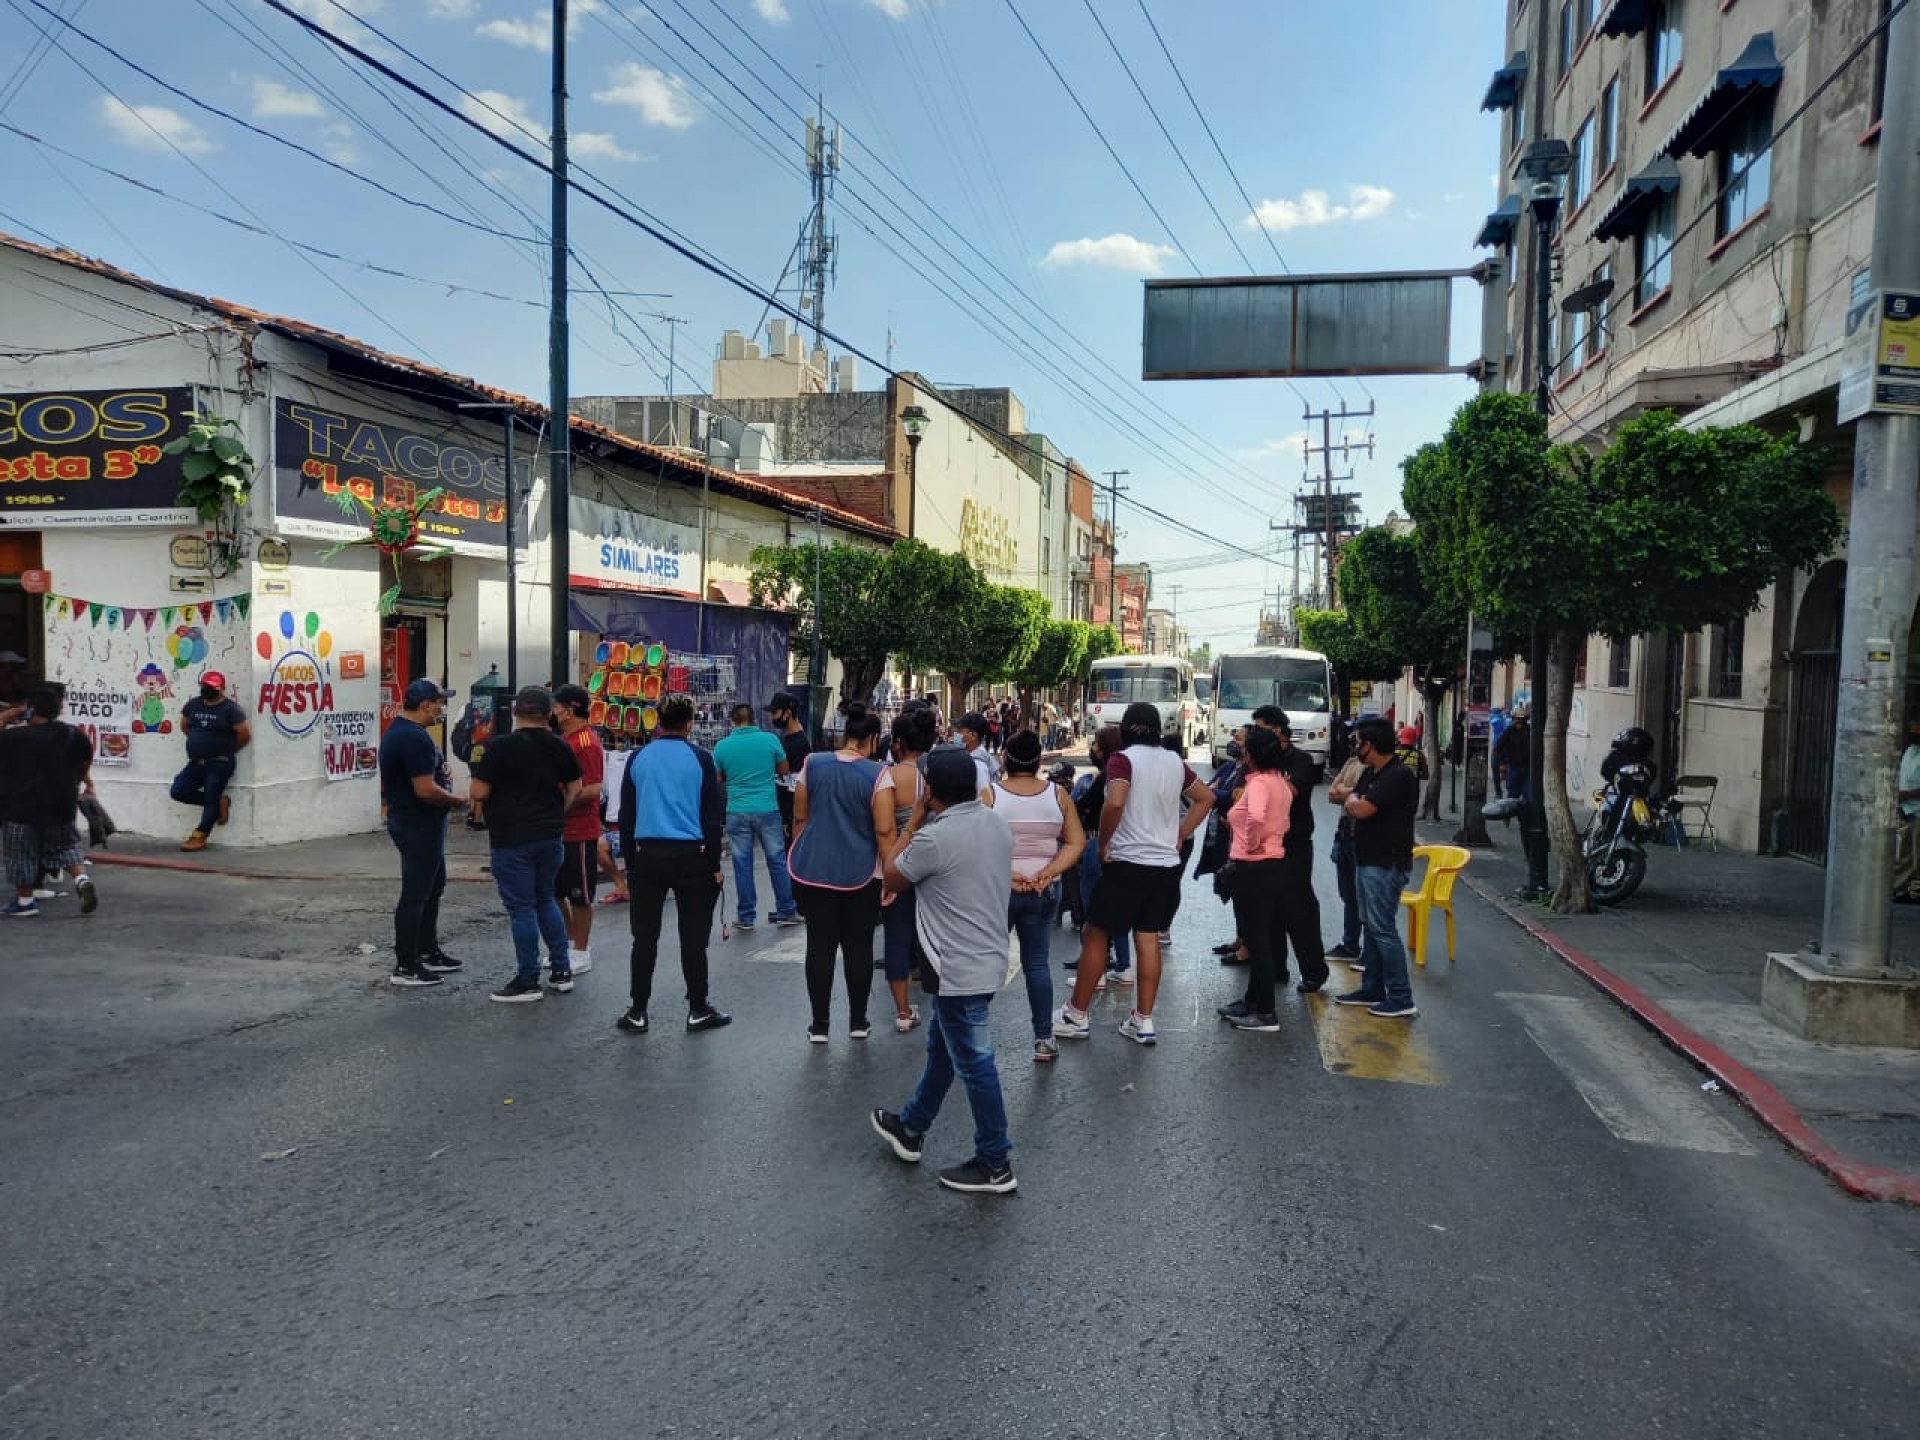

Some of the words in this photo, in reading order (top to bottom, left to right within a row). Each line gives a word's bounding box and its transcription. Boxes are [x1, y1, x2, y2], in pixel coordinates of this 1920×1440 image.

[290, 405, 518, 494] TACOS
[137, 513, 189, 522] Centro
[601, 544, 679, 579] SIMILARES
[278, 666, 315, 681] TACOS
[258, 682, 334, 715] FIESTA
[68, 703, 112, 717] TACO
[336, 724, 365, 736] TACO
